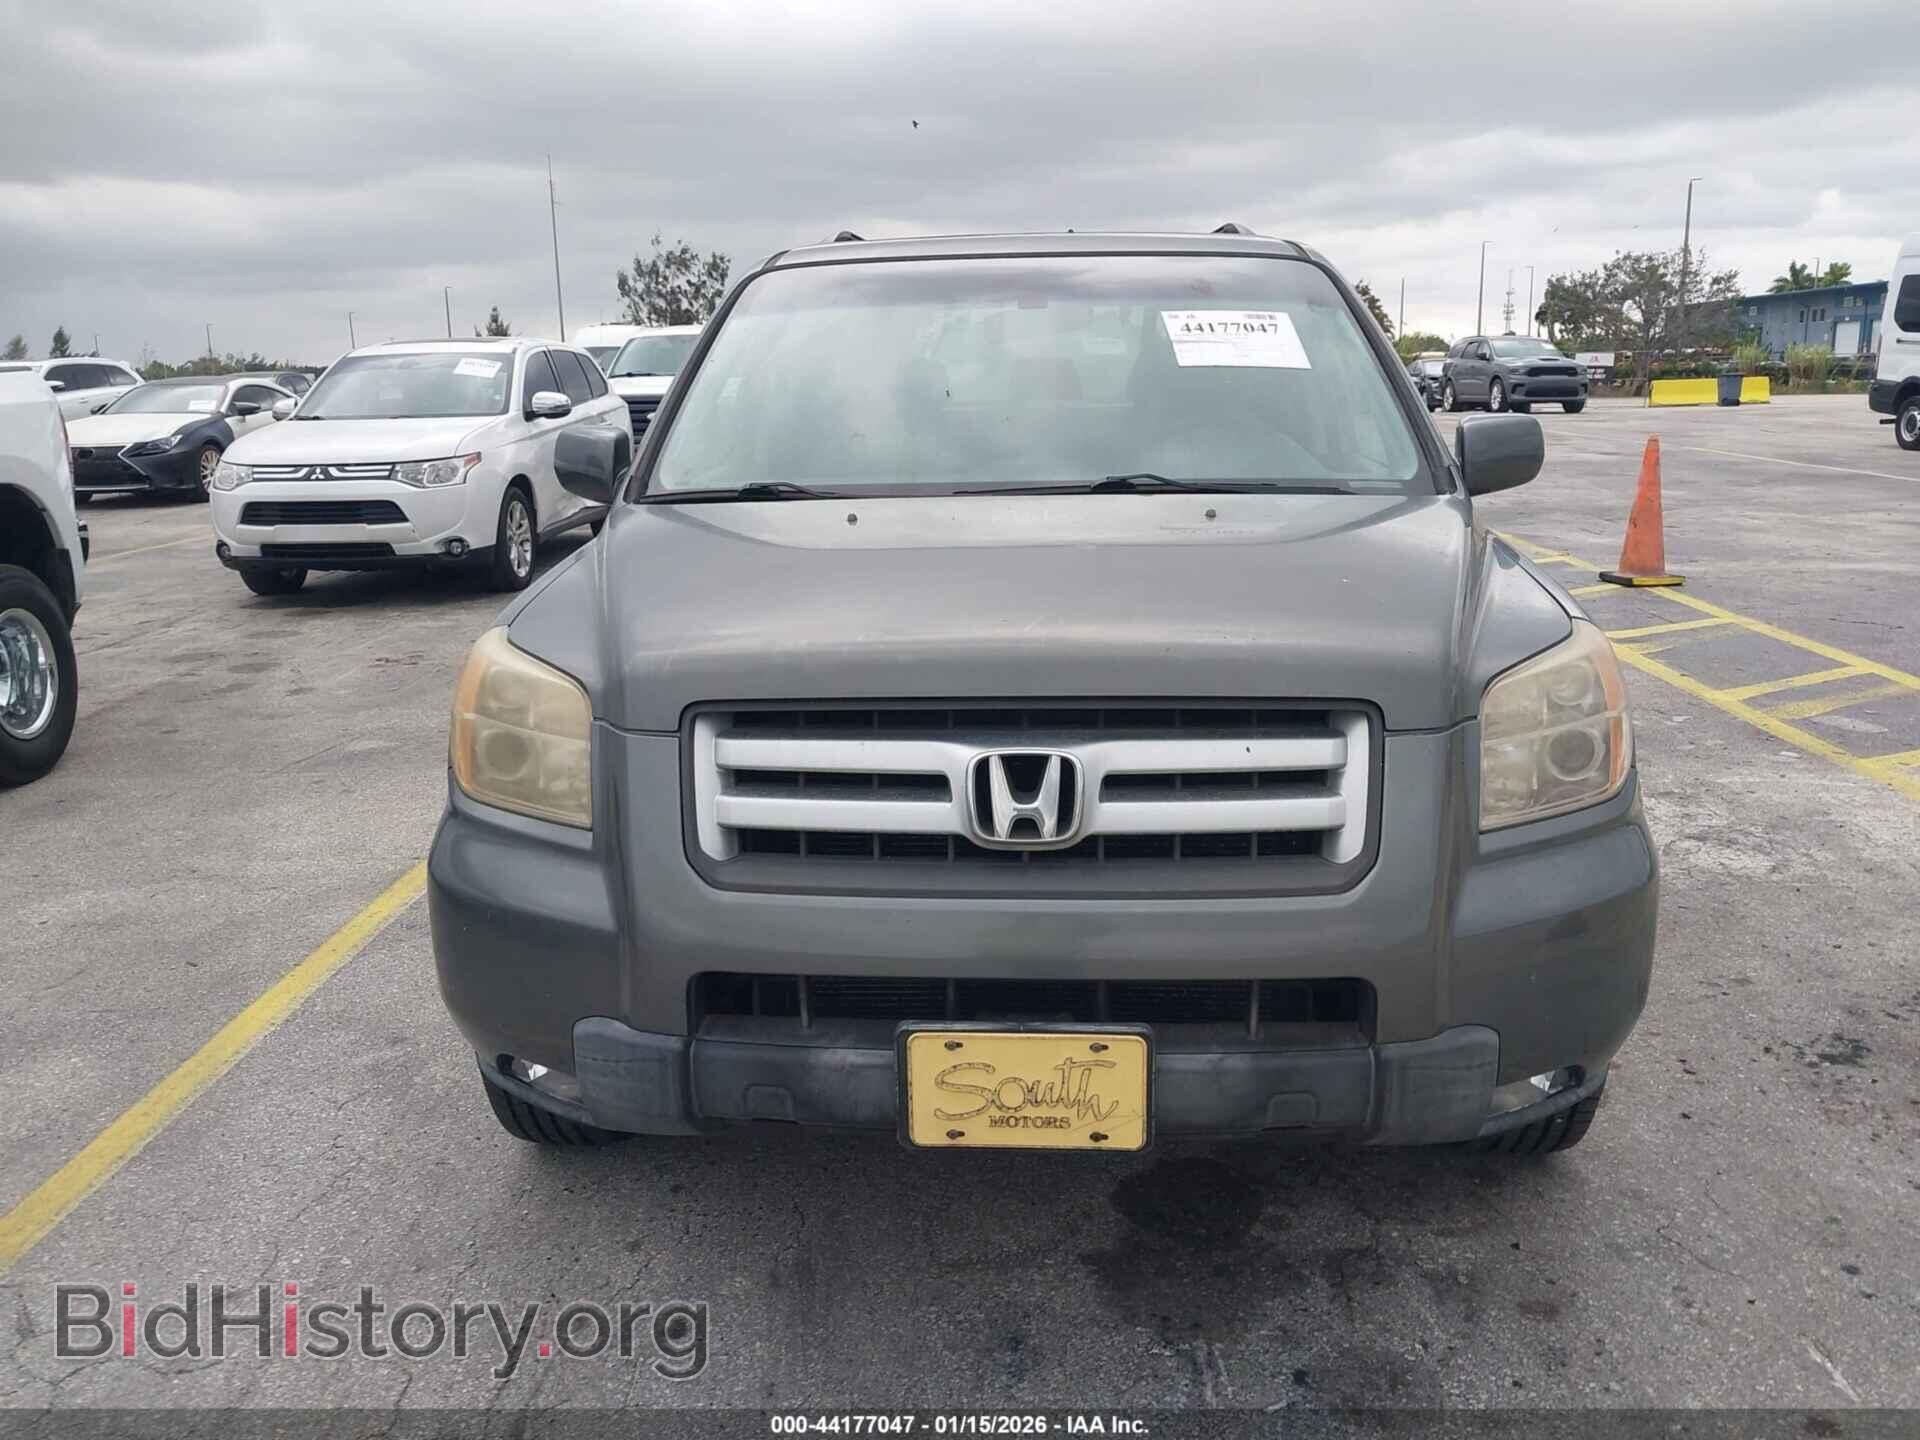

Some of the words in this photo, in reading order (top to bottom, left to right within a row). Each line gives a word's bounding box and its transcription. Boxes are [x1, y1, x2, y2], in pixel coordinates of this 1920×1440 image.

[1180, 321, 1279, 335] 44177047
[933, 1057, 1120, 1121] South
[988, 1115, 1072, 1129] MOTORS
